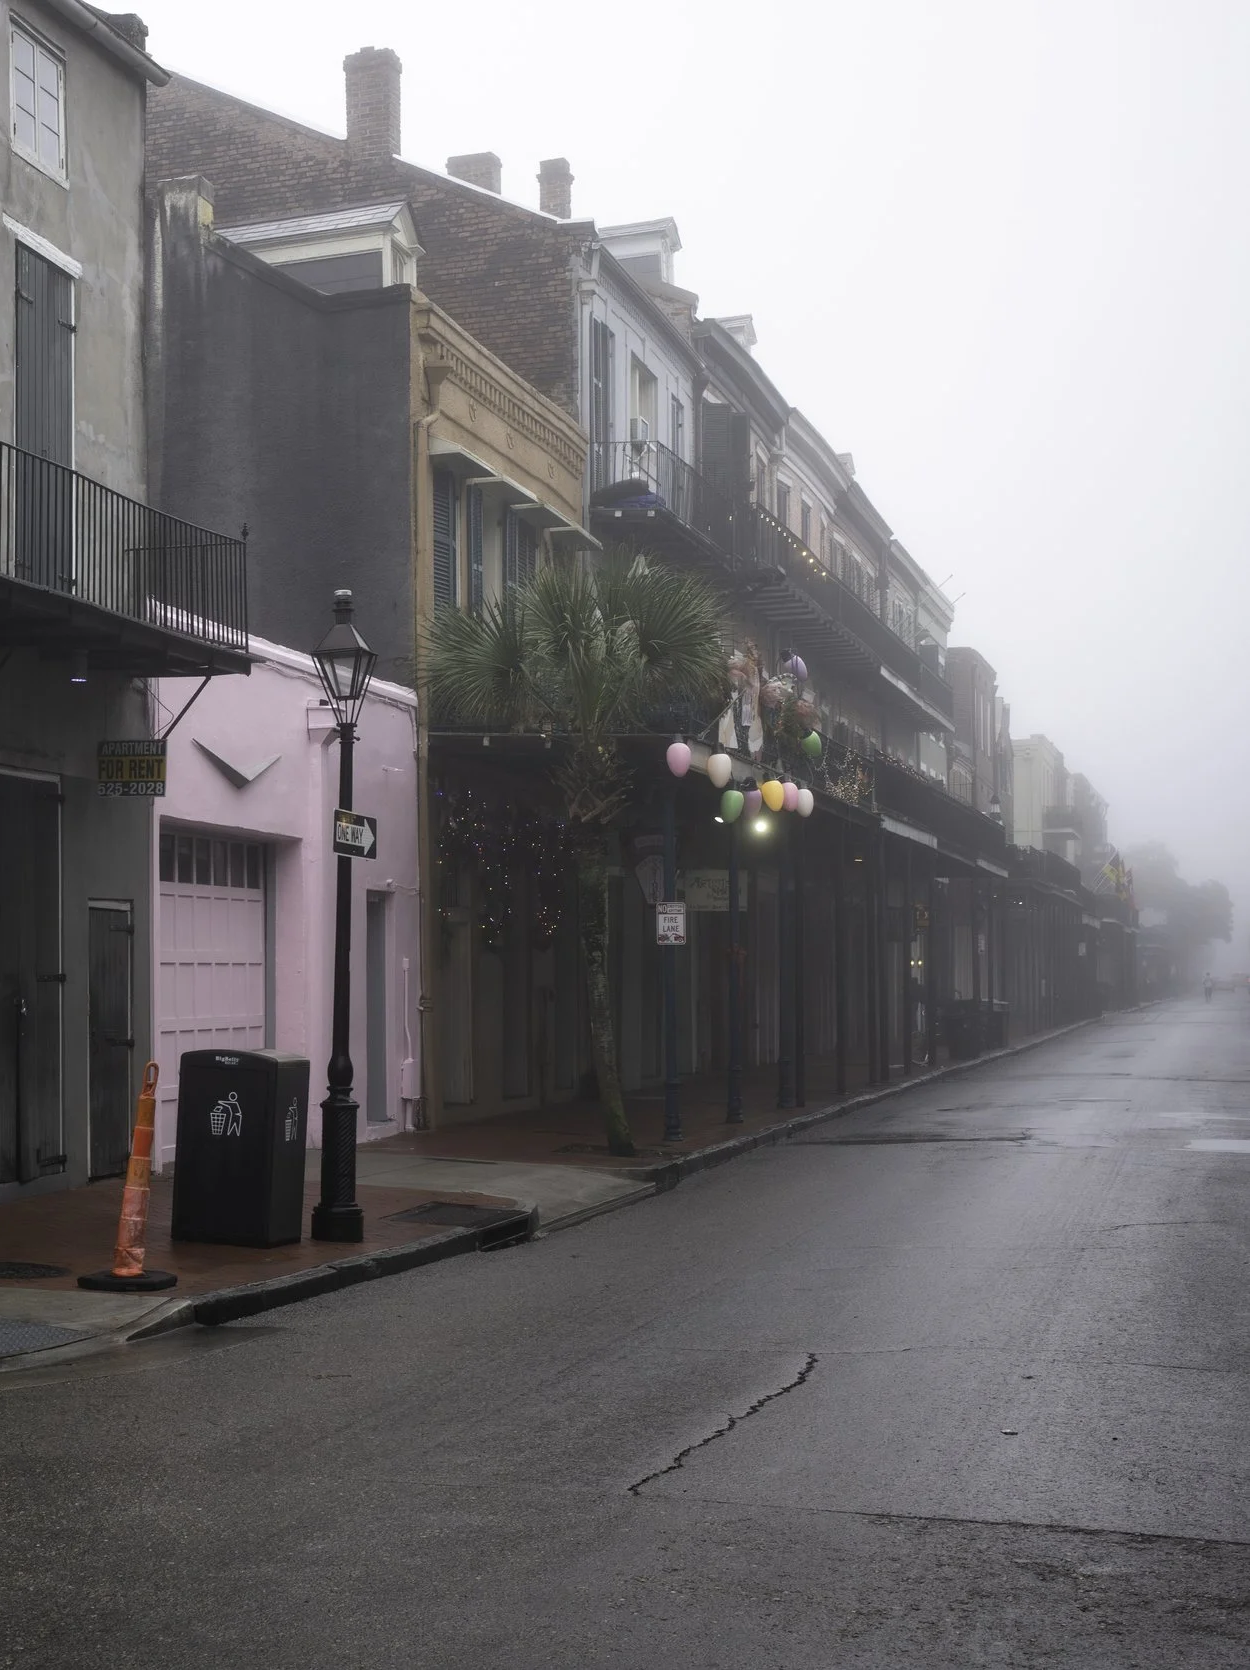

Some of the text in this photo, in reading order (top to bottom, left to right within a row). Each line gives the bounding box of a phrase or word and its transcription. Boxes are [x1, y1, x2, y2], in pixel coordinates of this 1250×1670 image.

[102, 742, 164, 755] APARTMENT
[98, 758, 163, 780] FOR RENT
[338, 823, 364, 844] ONE WAY
[658, 904, 667, 913] NO
[663, 916, 679, 924] FIRE
